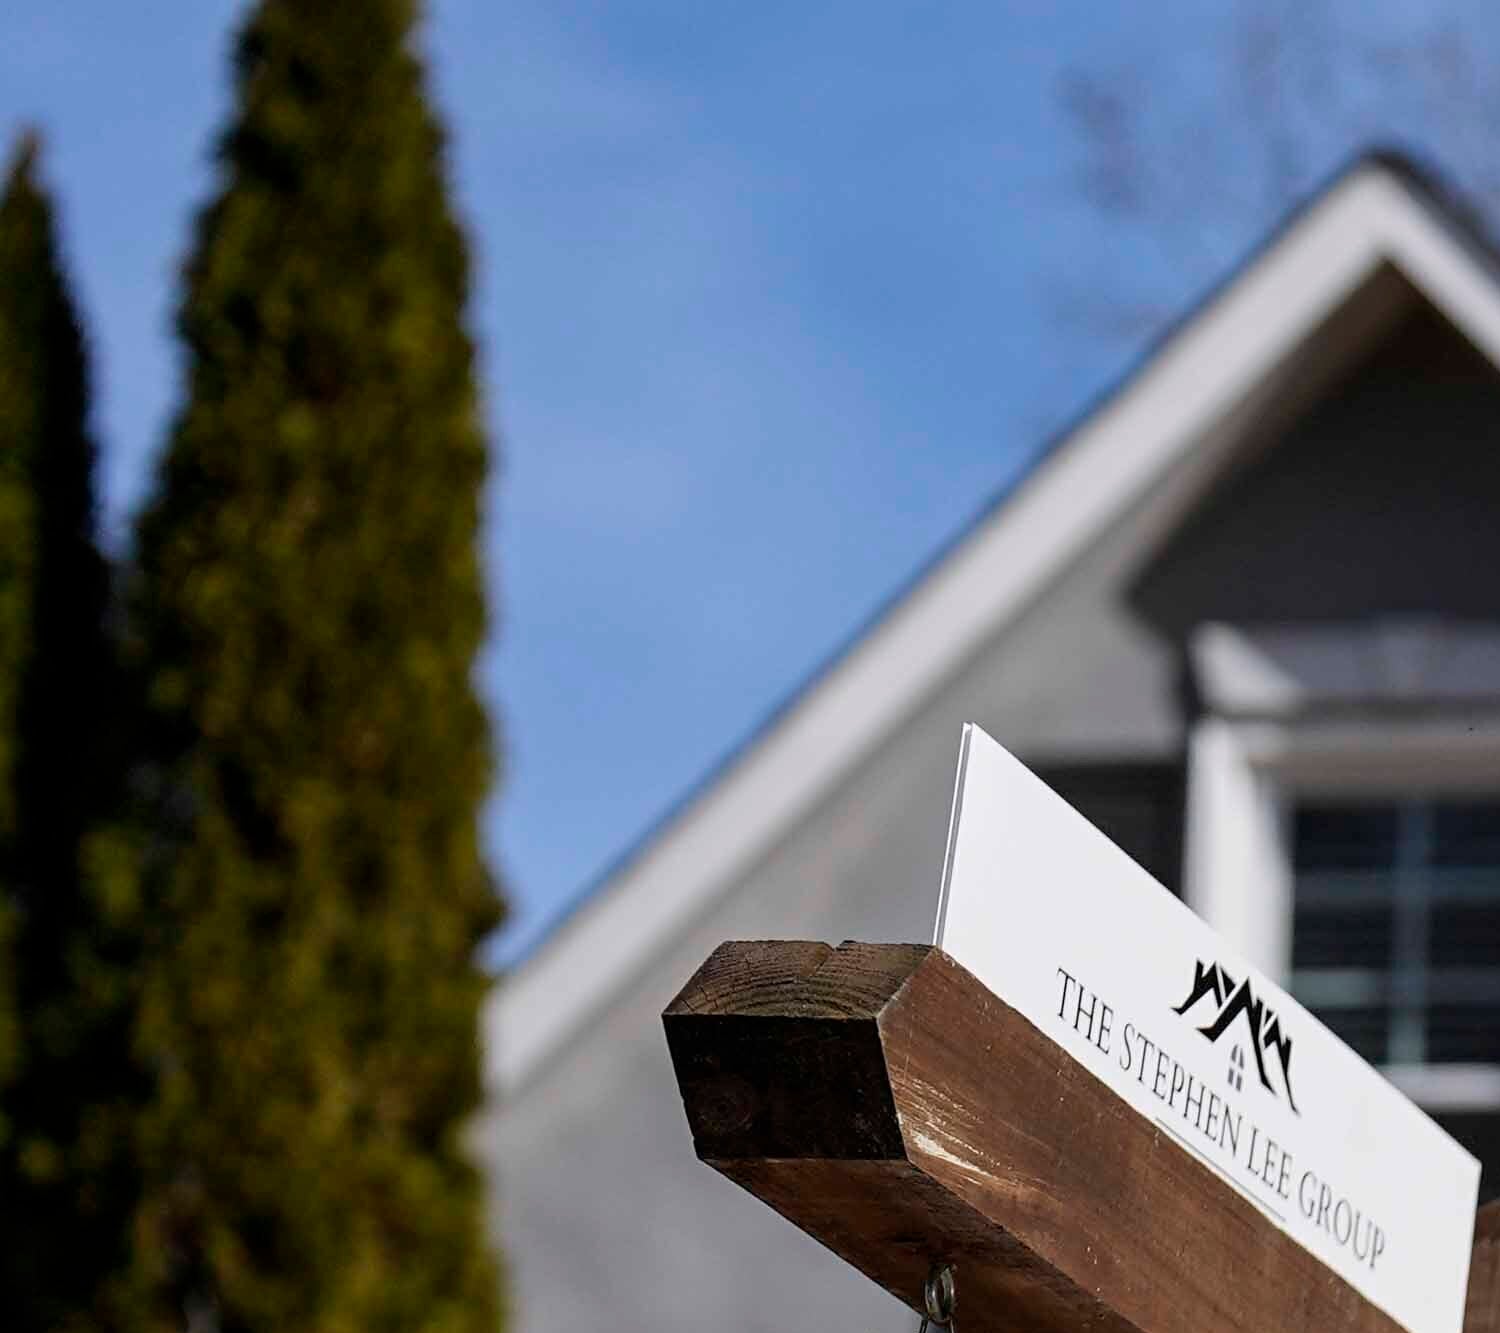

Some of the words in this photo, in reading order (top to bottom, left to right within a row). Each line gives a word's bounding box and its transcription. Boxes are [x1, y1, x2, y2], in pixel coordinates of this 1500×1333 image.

[1057, 967, 1114, 1055] THE
[1119, 1022, 1243, 1157] STEPHEN
[1247, 1126, 1293, 1200] LEE
[1299, 1170, 1385, 1270] GROUP
